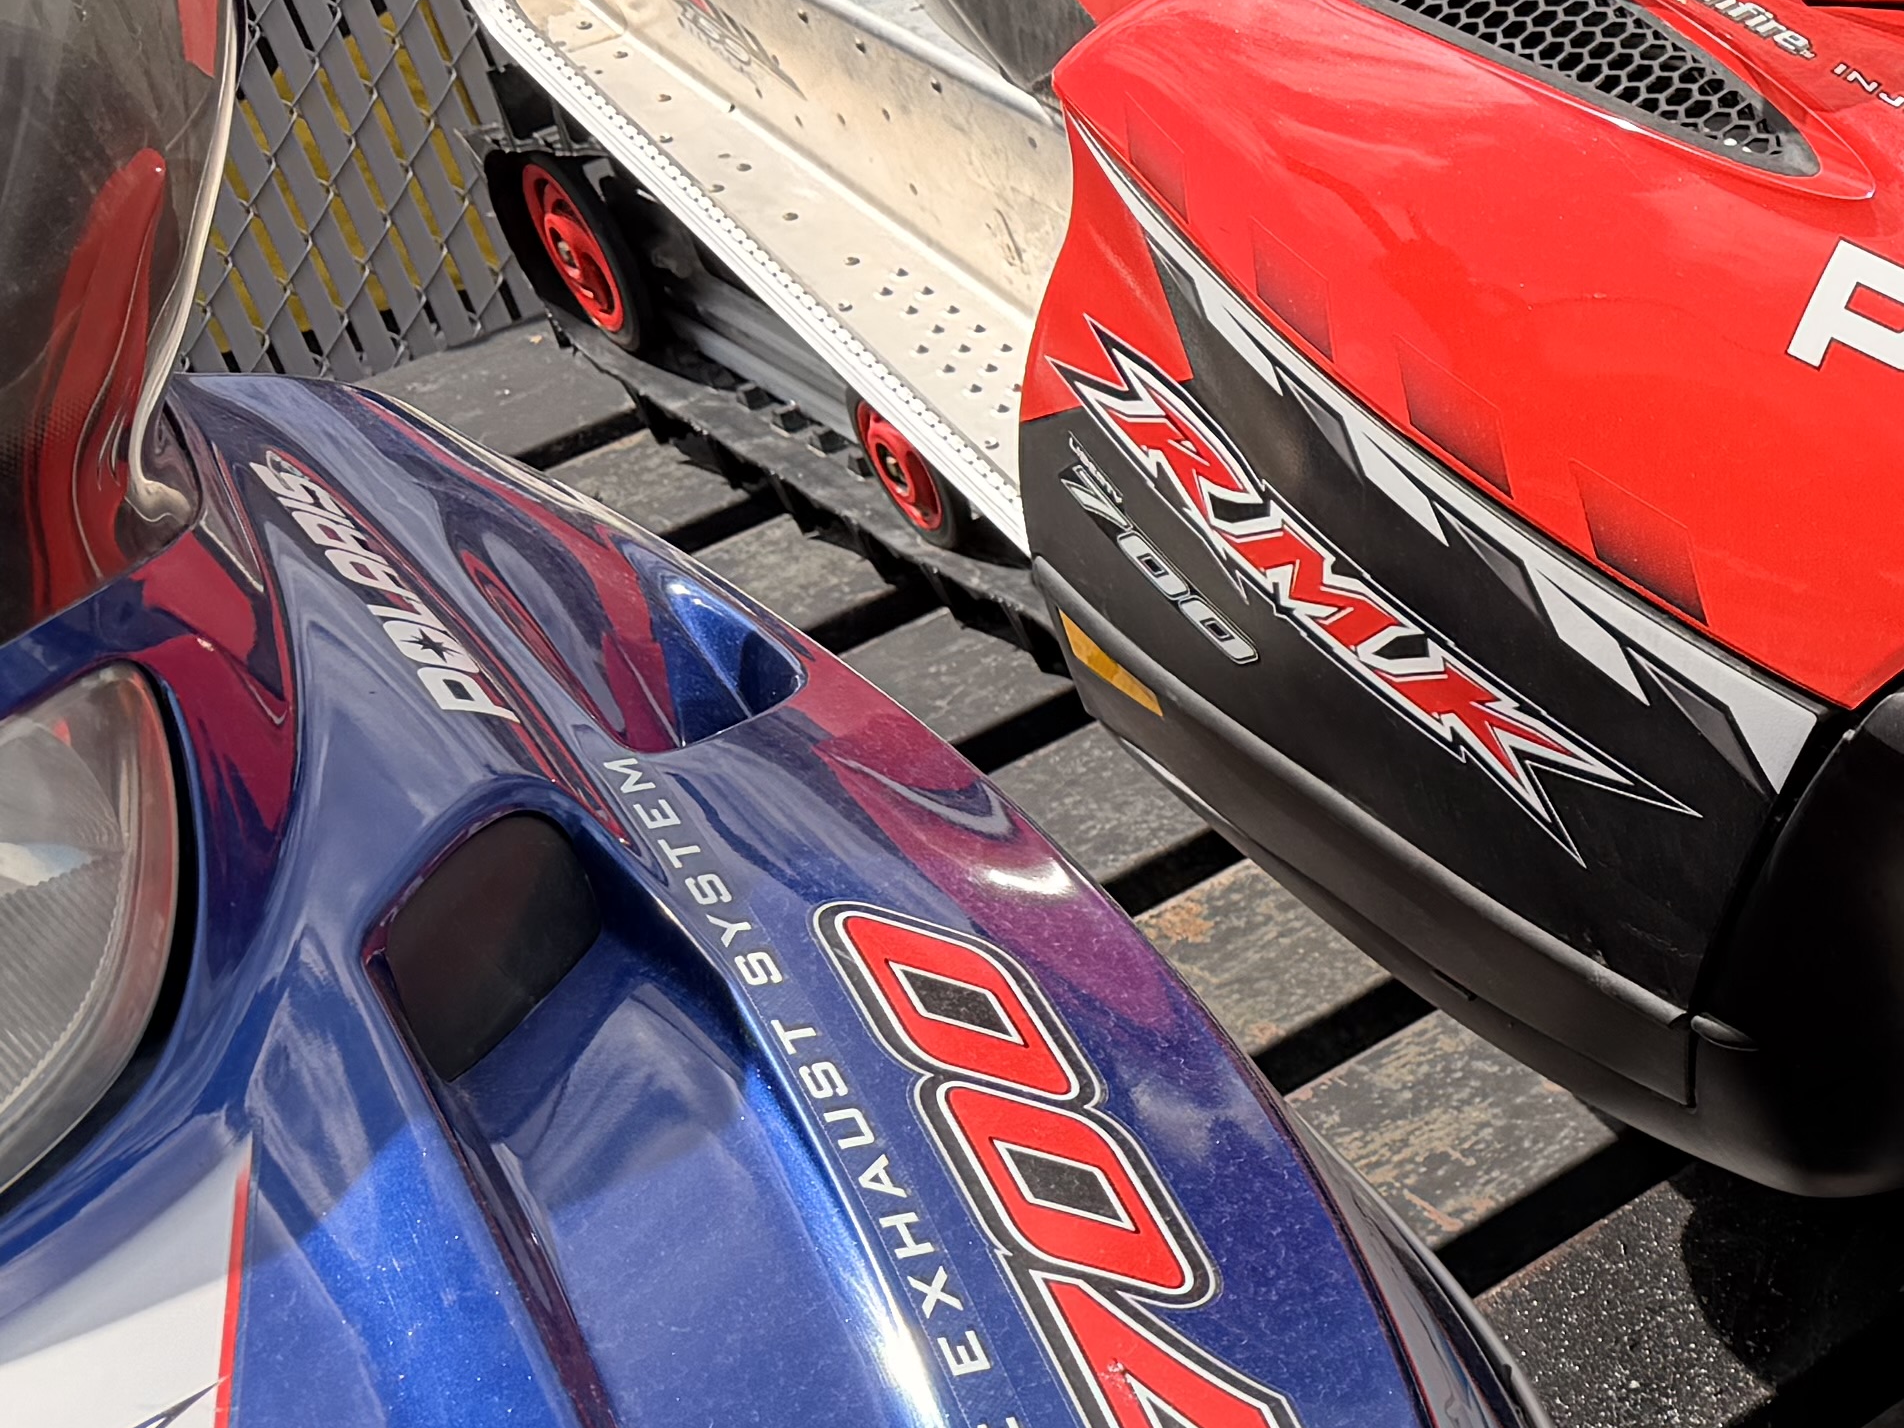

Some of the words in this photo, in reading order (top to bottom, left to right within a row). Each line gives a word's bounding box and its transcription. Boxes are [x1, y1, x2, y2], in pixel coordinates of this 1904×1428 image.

[248, 456, 522, 725] POLARIS
[1048, 316, 1690, 860] RMK
[1060, 464, 1260, 665] 700
[603, 757, 784, 987] SYSTEM
[783, 1018, 993, 1378] EXHAUST
